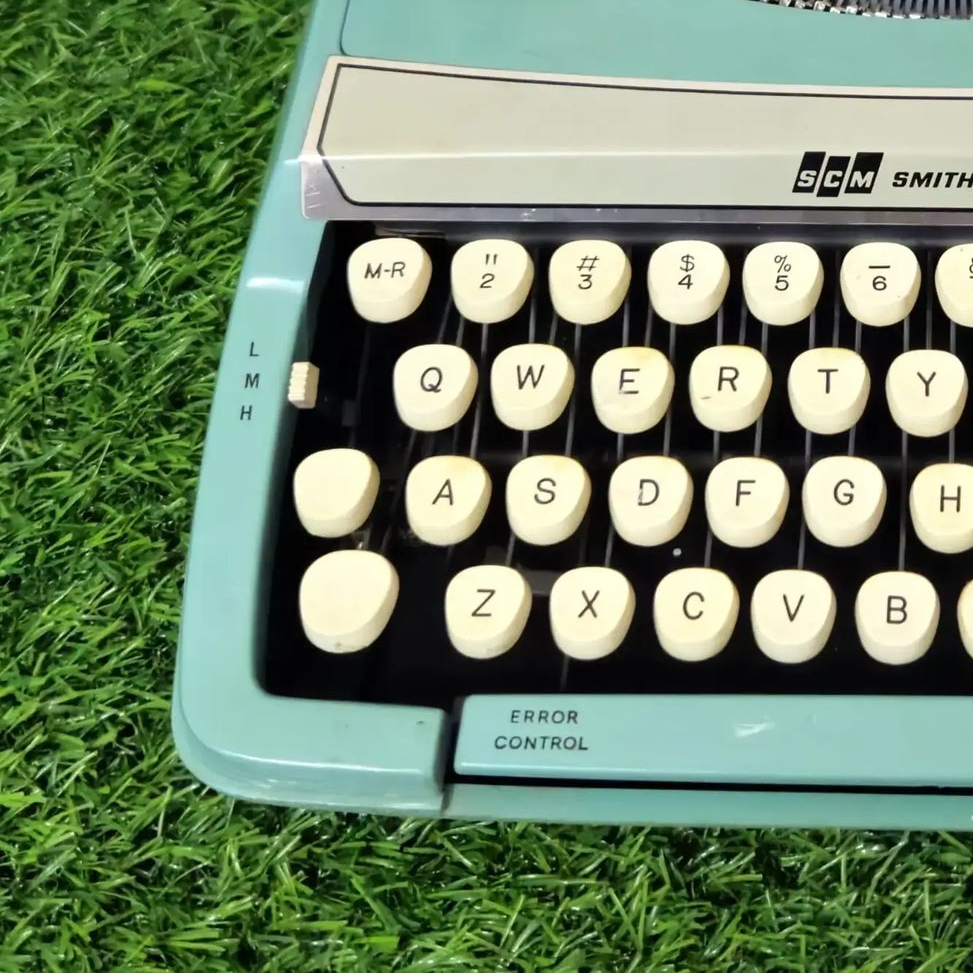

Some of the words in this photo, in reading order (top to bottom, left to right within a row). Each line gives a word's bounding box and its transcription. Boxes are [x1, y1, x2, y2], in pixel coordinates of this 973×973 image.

[364, 261, 406, 279] M-R
[576, 255, 599, 272] #
[679, 253, 695, 273] $
[773, 254, 792, 274] %
[479, 273, 495, 289] 2
[578, 274, 593, 290] 3
[677, 274, 694, 290] 4
[774, 275, 790, 291] 5
[872, 275, 888, 291] 6
[249, 341, 259, 357] L
[244, 373, 259, 389] M
[420, 366, 443, 393] Q
[516, 364, 545, 390] W
[618, 368, 640, 394] E
[717, 366, 740, 392] R
[817, 368, 838, 394] T
[917, 371, 936, 397] Y
[240, 405, 252, 421] H
[431, 478, 454, 506] A
[533, 478, 557, 505] S
[638, 479, 660, 506] D
[735, 480, 756, 507] F
[833, 479, 855, 506] G
[940, 485, 961, 513] H
[471, 589, 496, 617] Z
[578, 590, 600, 618] X
[682, 591, 705, 620] C
[782, 594, 805, 622] V
[886, 595, 908, 624] B
[510, 709, 579, 725] ERROR
[494, 735, 589, 751] CONTROL
